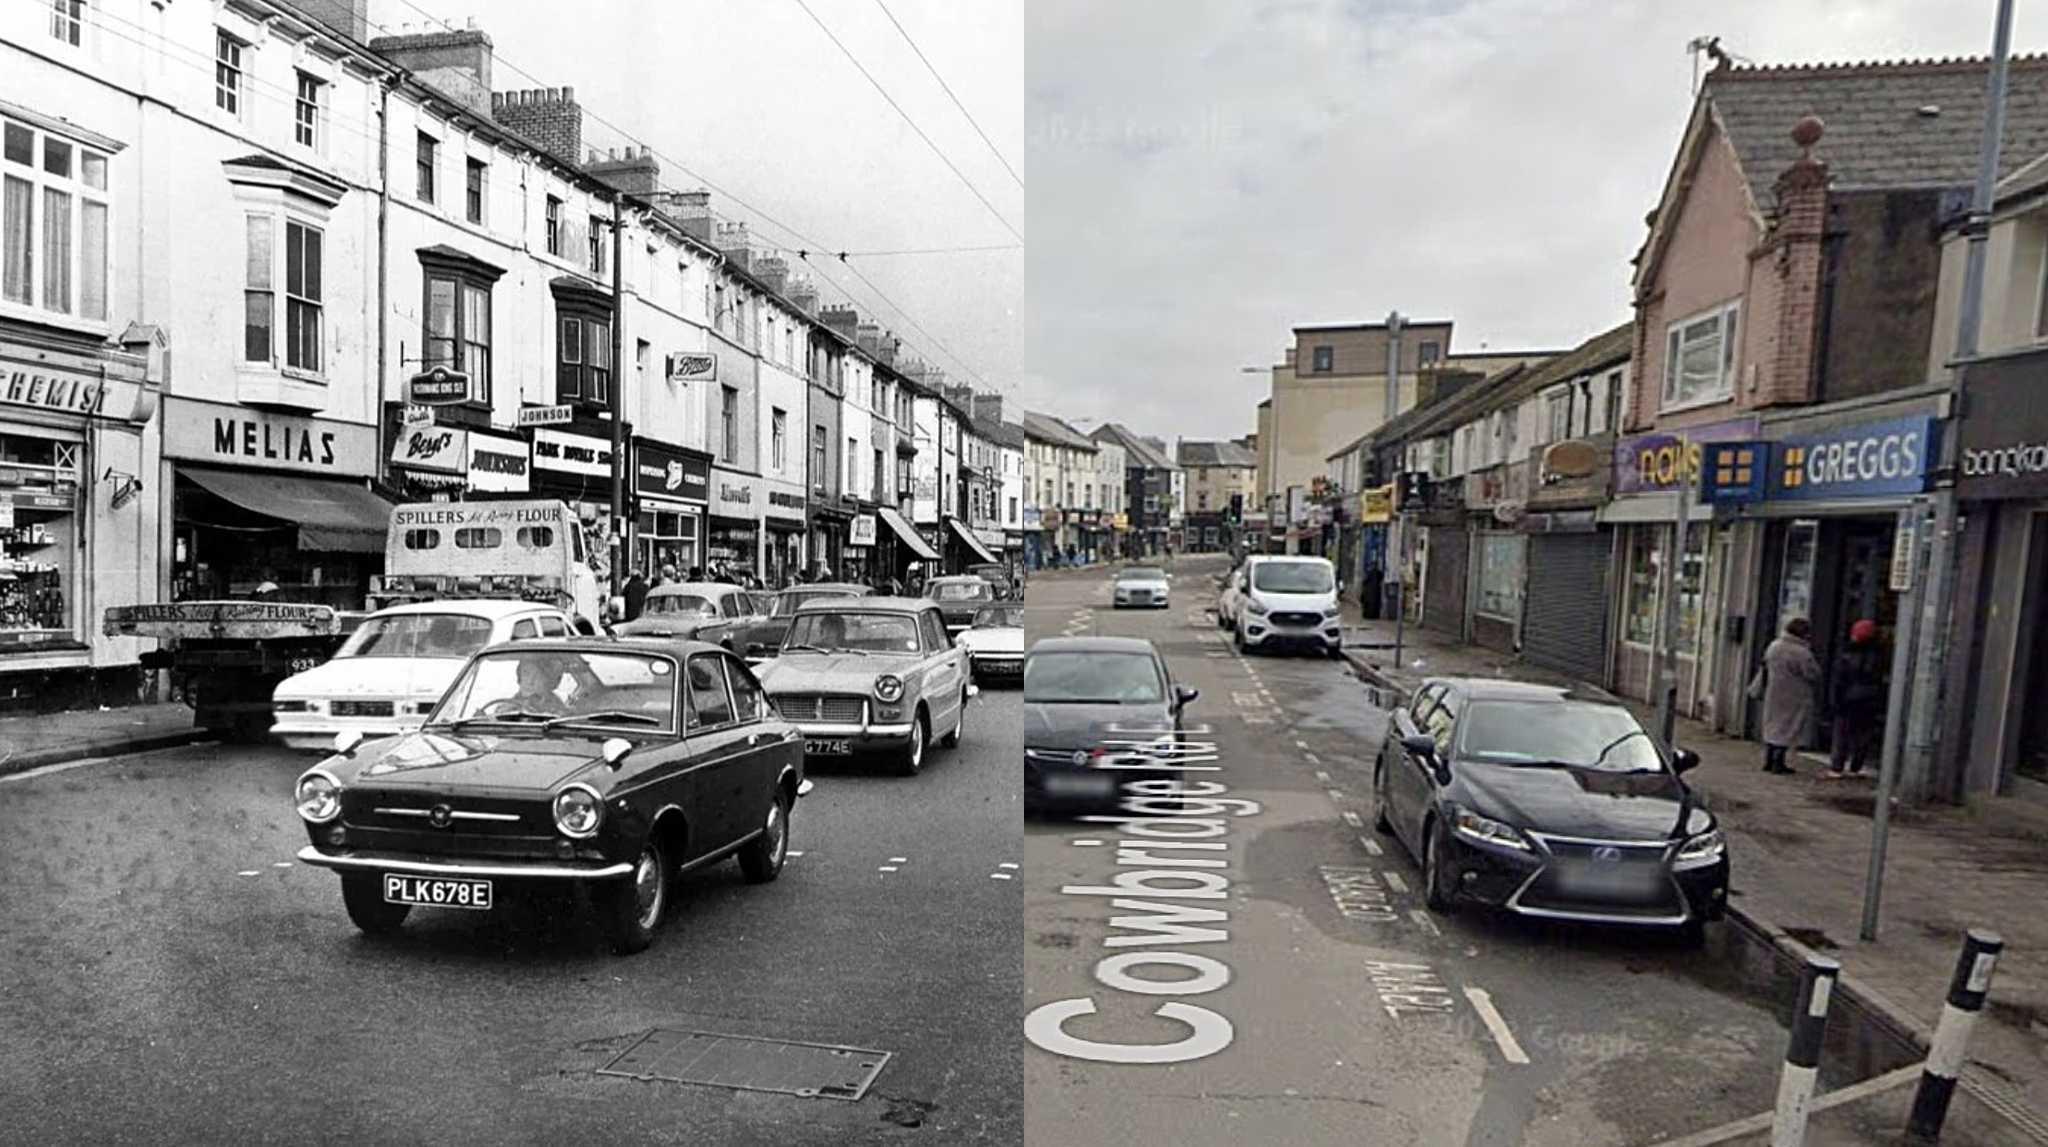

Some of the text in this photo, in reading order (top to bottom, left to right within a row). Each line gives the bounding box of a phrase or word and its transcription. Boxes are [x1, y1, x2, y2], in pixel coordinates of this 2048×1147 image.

[214, 417, 335, 465] MELIAS
[1807, 431, 1919, 485] GREGGS
[1961, 441, 2048, 478] bangko
[396, 510, 465, 525] SPILLERS
[516, 508, 562, 522] FLOUR
[127, 606, 187, 620] SPILLERS
[267, 606, 308, 619] FLOUR
[387, 877, 488, 906] PLK678E
